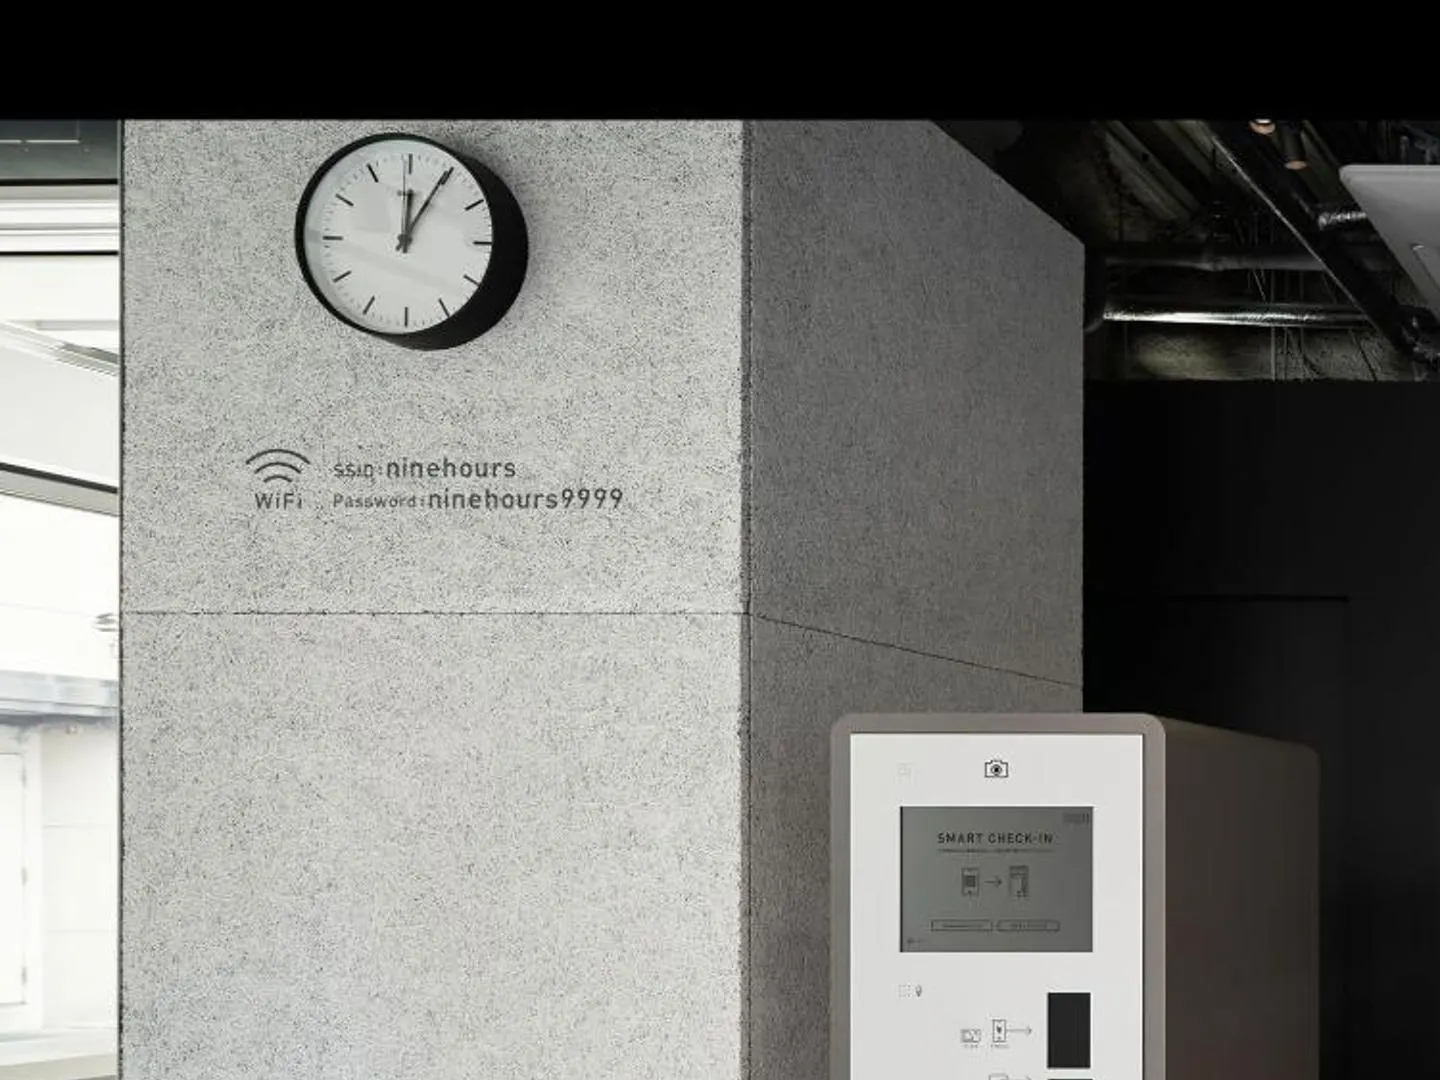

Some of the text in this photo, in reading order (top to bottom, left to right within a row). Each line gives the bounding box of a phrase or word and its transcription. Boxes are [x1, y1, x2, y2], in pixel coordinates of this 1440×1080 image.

[254, 492, 302, 510] WiFi
[937, 832, 1054, 845] SMART CHECK-IN
